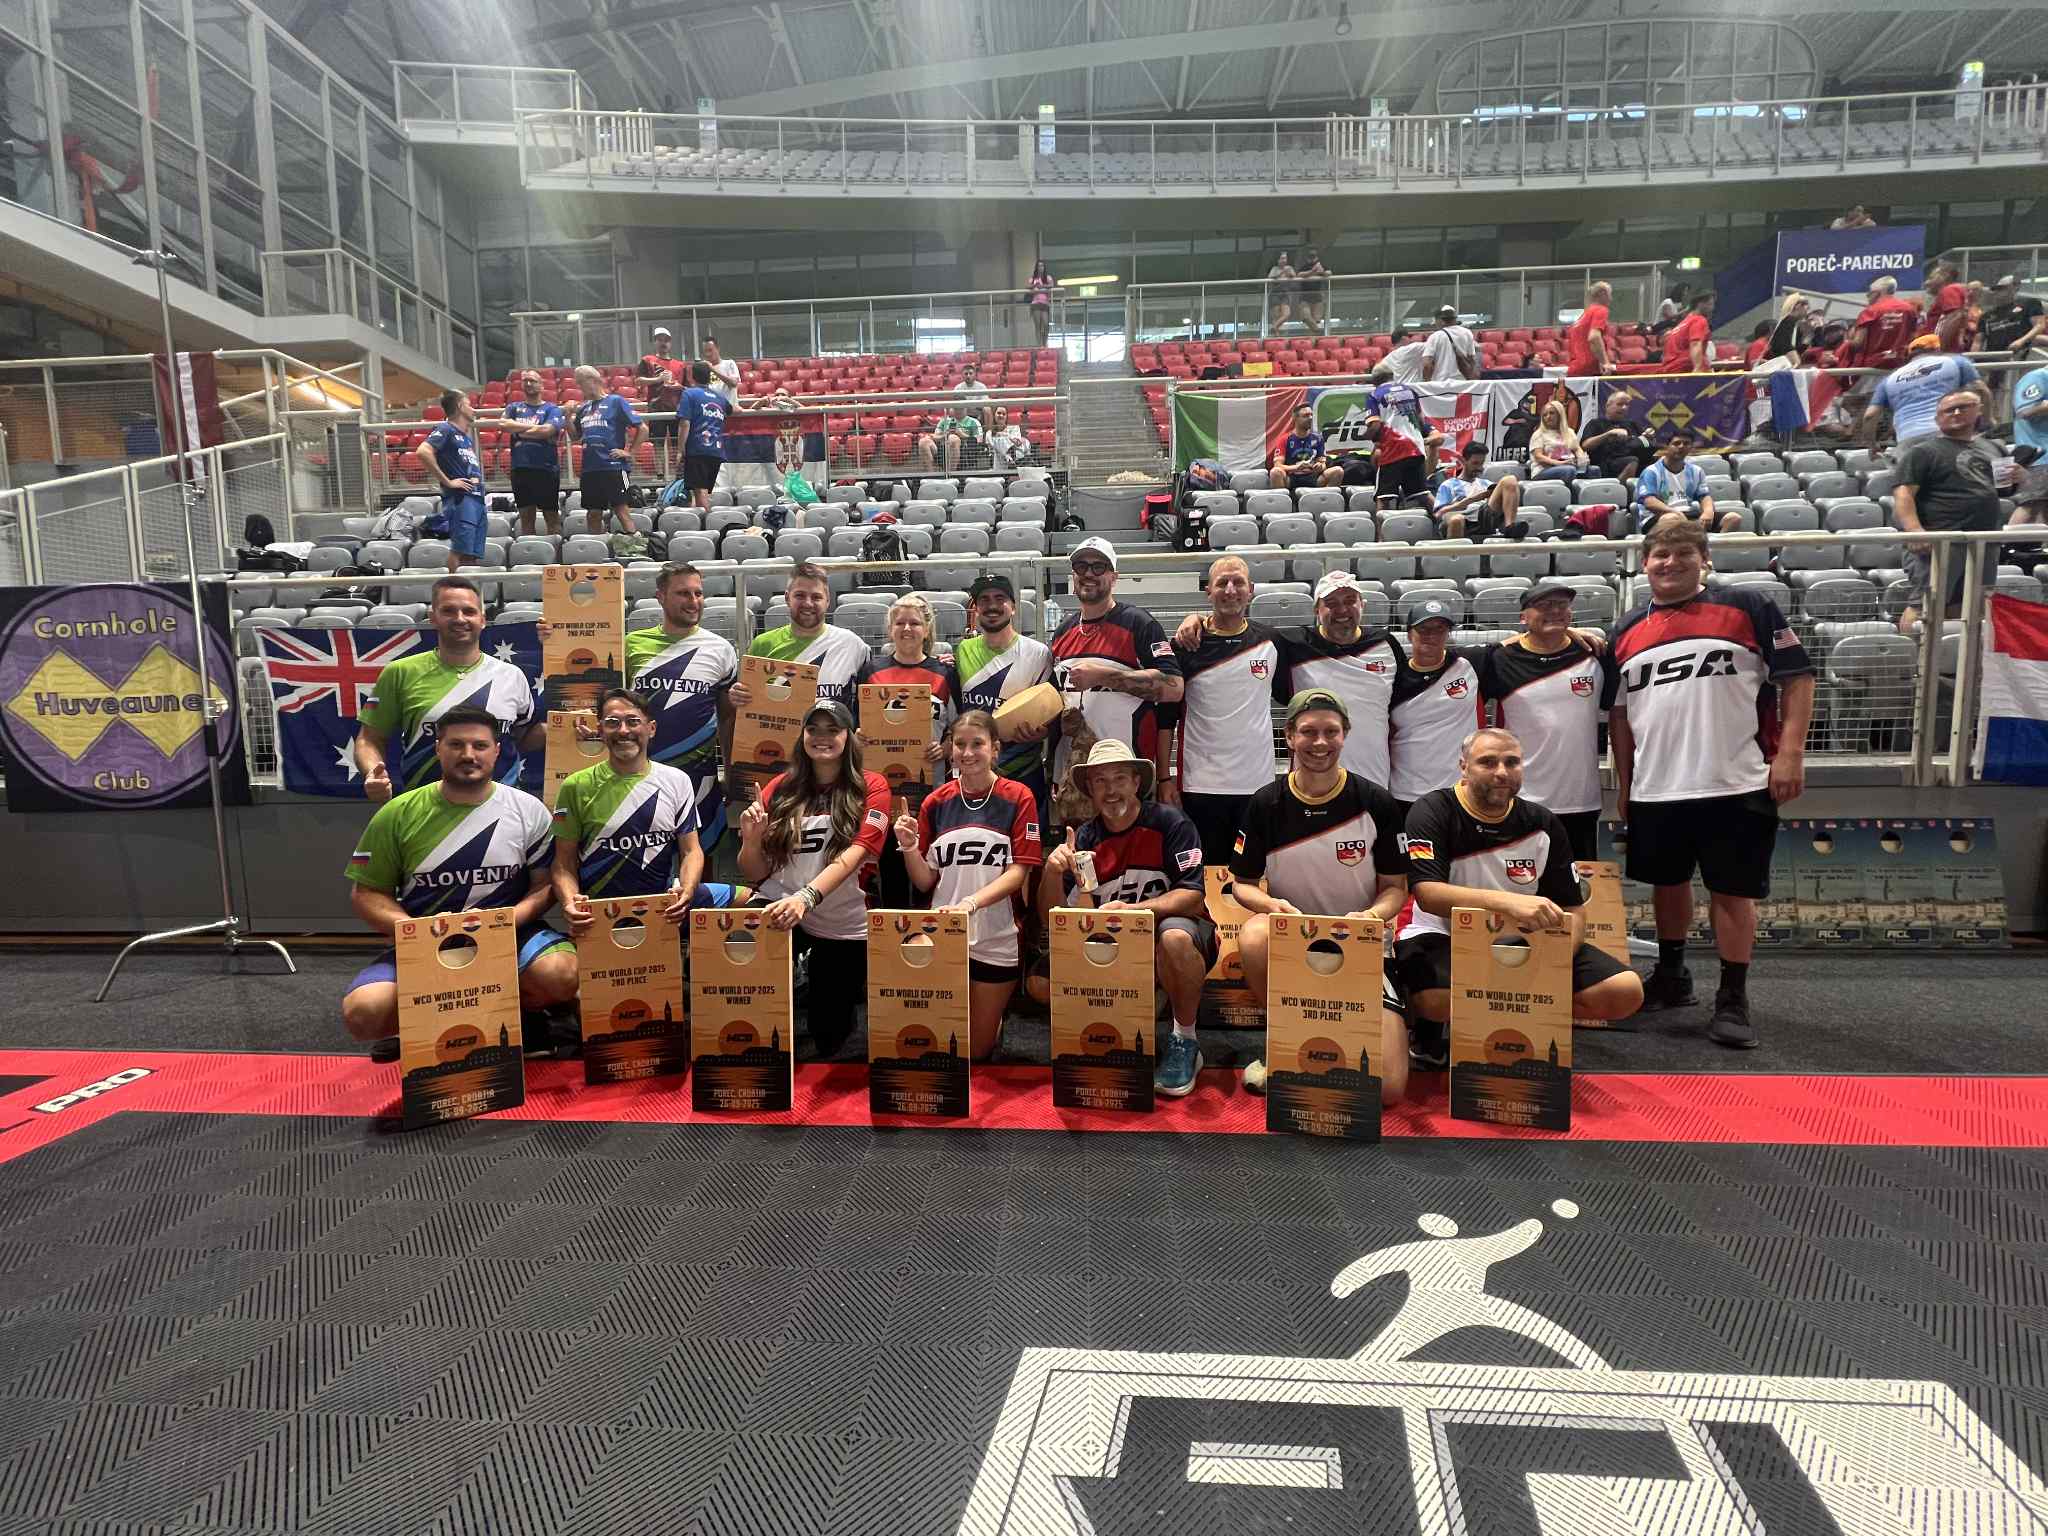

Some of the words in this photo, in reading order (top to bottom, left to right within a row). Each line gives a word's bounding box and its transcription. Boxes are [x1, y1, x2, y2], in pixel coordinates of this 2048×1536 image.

[1787, 253, 1914, 273] POREČ-PARENZO
[1444, 422, 1481, 432] PADOV
[33, 609, 177, 639] Cornhole
[1624, 649, 1738, 693] USA
[635, 676, 711, 695] SLOVENIA
[1572, 676, 1593, 684] DCO
[34, 692, 202, 716] Huveaune
[962, 692, 1003, 708] SLOVE
[94, 769, 151, 791] Club
[1337, 841, 1365, 850] DCO
[934, 840, 1013, 867] USA
[1507, 860, 1534, 868] DCO
[608, 968, 632, 978] WORLD
[634, 966, 647, 976] CUP
[649, 964, 666, 974] 2025
[434, 990, 462, 1000] WORLD
[464, 987, 479, 997] CUP
[481, 984, 501, 994] 2025
[719, 986, 741, 995] WORLD
[743, 986, 756, 995] CUP
[758, 986, 775, 995] 2025
[896, 989, 919, 998] WORLD
[921, 989, 935, 999] CUP
[936, 990, 953, 1000] 2025
[1080, 987, 1104, 997] WORLD
[1105, 988, 1119, 998] CUP
[1121, 989, 1139, 999] 2025
[726, 996, 751, 1005] WINNER
[1088, 998, 1113, 1008] WINNER
[1486, 991, 1513, 1001] WORLD
[1515, 992, 1531, 1003] CUP
[1533, 994, 1554, 1004] 2025
[438, 1002, 453, 1012] 2ND
[456, 998, 480, 1009] PLACE
[904, 1000, 929, 1009] WINNER
[1300, 999, 1326, 1009] WORLD
[1328, 1000, 1343, 1010] CUP
[1345, 1002, 1365, 1012] 2025
[1489, 1002, 1504, 1011] 3RD
[1506, 1003, 1530, 1014] PLACE
[1303, 1010, 1318, 1019] 3RD
[1320, 1011, 1343, 1021] PLACE
[33, 1068, 154, 1113] PRO
